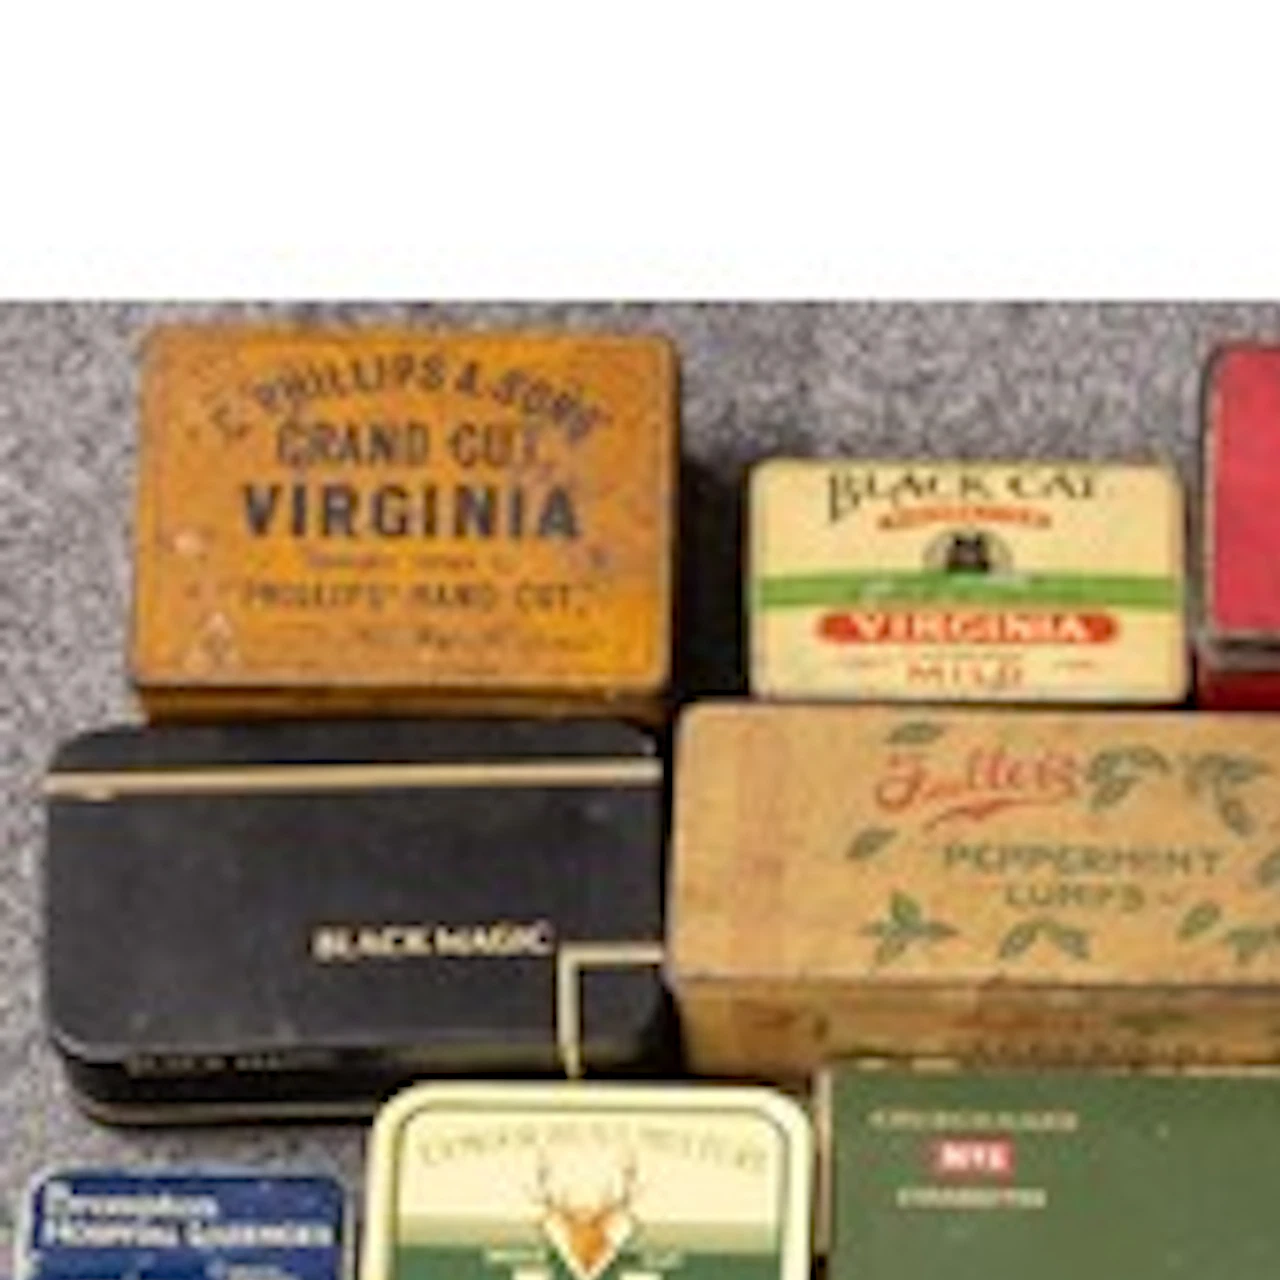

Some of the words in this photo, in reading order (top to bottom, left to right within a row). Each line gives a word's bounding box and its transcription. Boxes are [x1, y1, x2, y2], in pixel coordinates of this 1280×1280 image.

[275, 421, 430, 468] GRAND
[242, 482, 582, 539] VIRGINIA
[828, 470, 991, 523] BLACK
[852, 613, 1090, 643] VIRGINIA
[943, 842, 1223, 877] PEPPERMINT
[1004, 882, 1146, 909] LUMPS
[312, 926, 431, 962] BLACK
[435, 920, 556, 957] MAGIC
